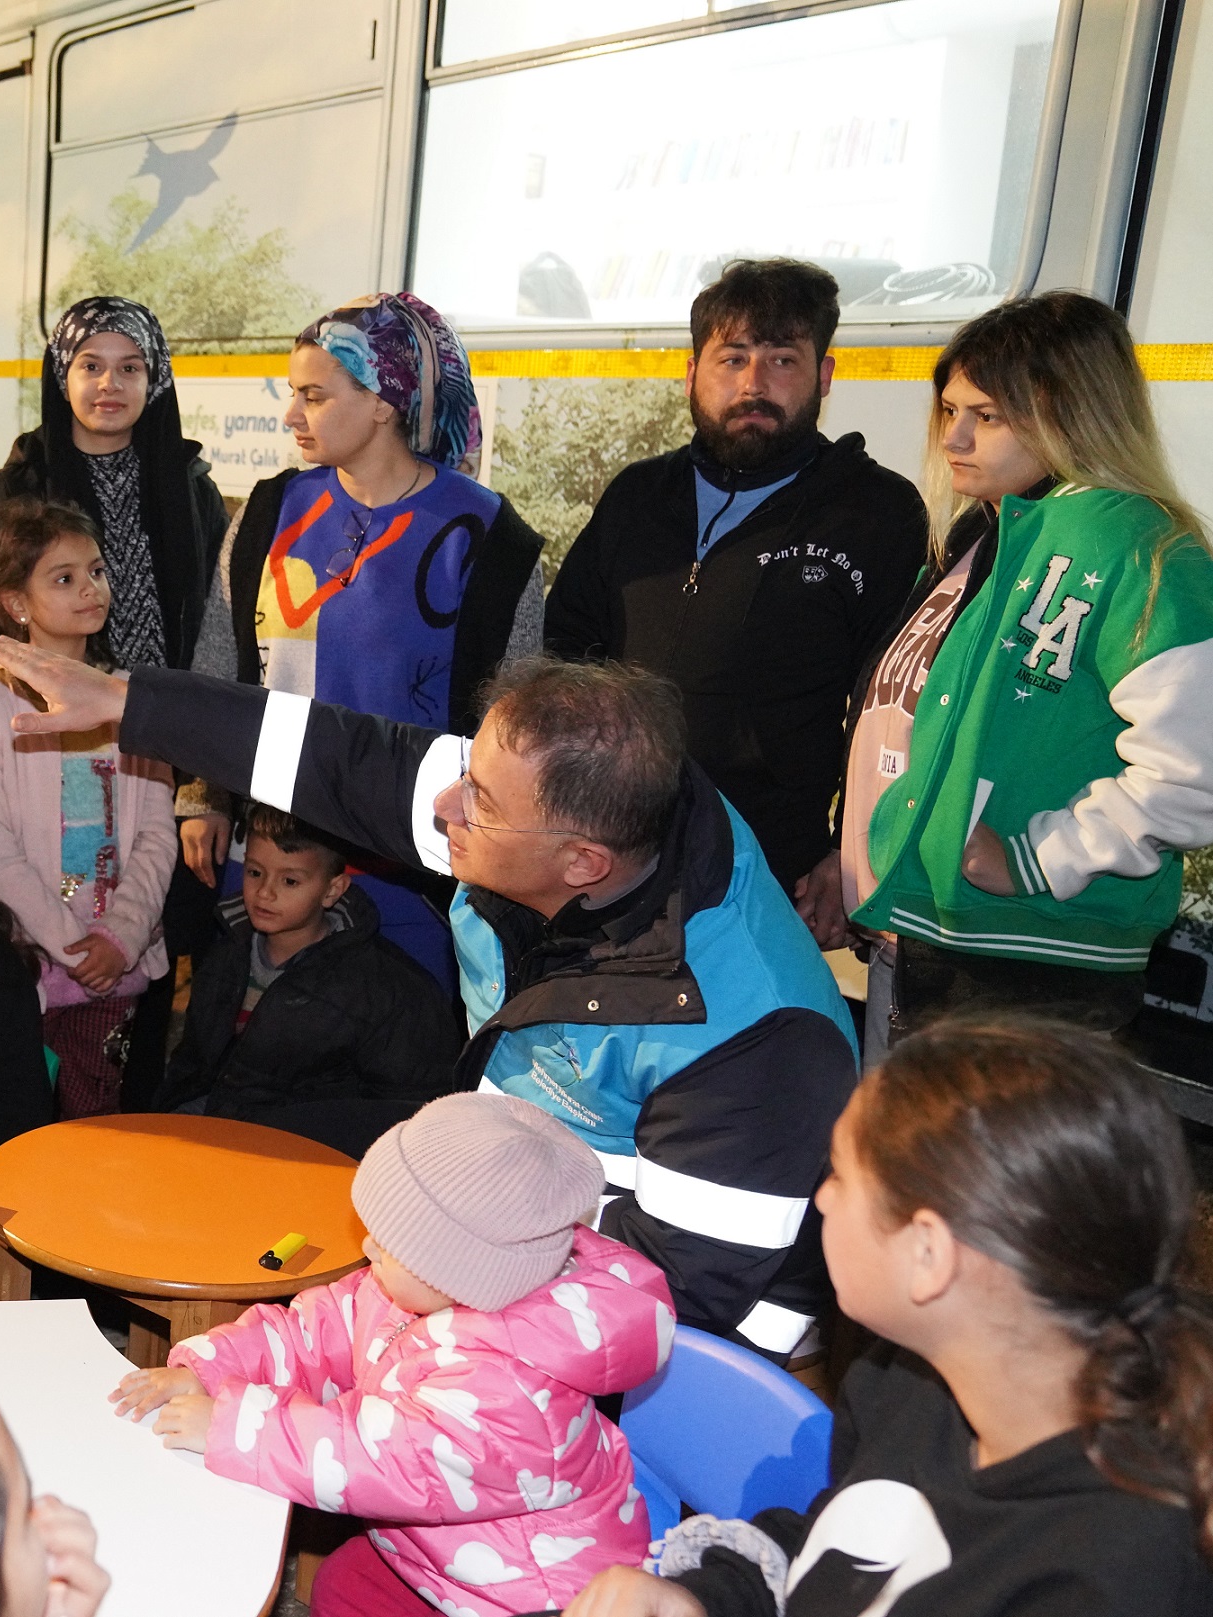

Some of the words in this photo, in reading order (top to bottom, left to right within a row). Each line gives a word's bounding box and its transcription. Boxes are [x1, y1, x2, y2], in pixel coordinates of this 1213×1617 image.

[211, 447, 246, 465] Murat
[806, 543, 829, 558] Let
[831, 552, 851, 570] No
[1018, 554, 1094, 682] LA
[1015, 630, 1034, 647] LOS
[1014, 668, 1062, 694] ANGELES
